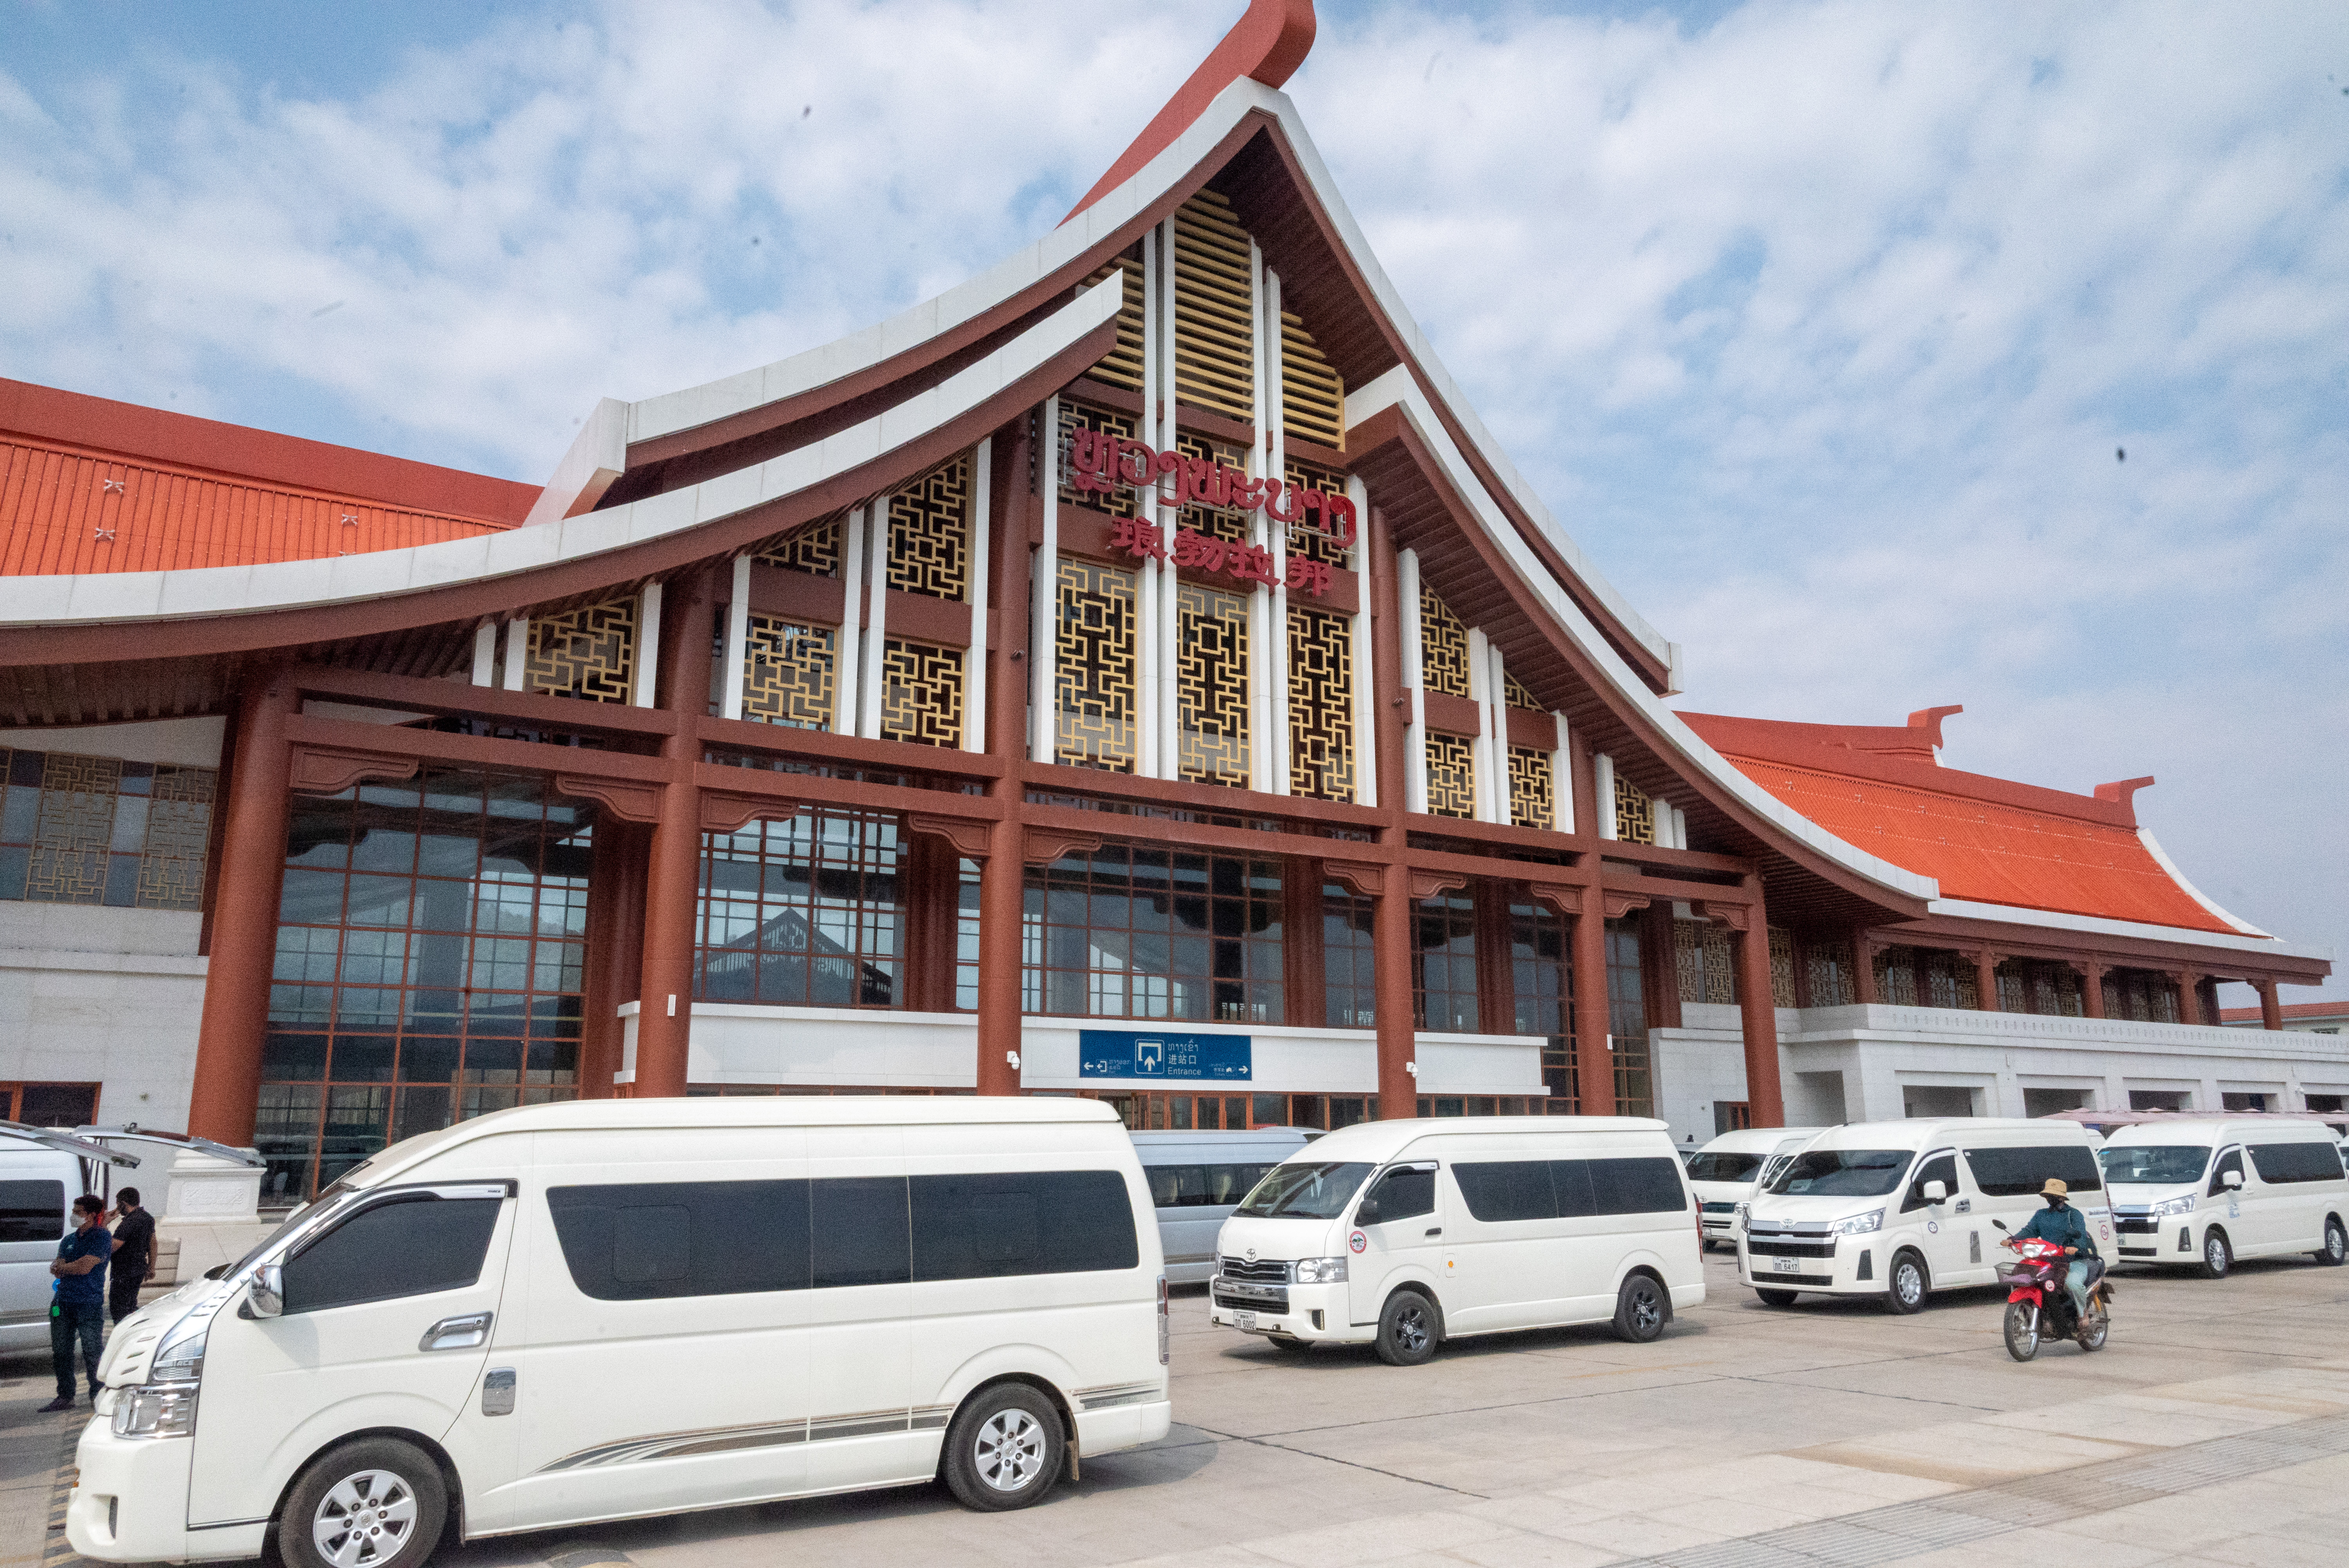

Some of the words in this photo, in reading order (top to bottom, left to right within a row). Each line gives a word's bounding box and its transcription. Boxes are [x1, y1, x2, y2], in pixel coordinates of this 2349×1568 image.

[1109, 516, 1332, 596] 琅勃拉邦
[1168, 1054, 1196, 1065] 进站口
[1168, 1067, 1202, 1075] Entrance
[1243, 1319, 1255, 1329] 6002
